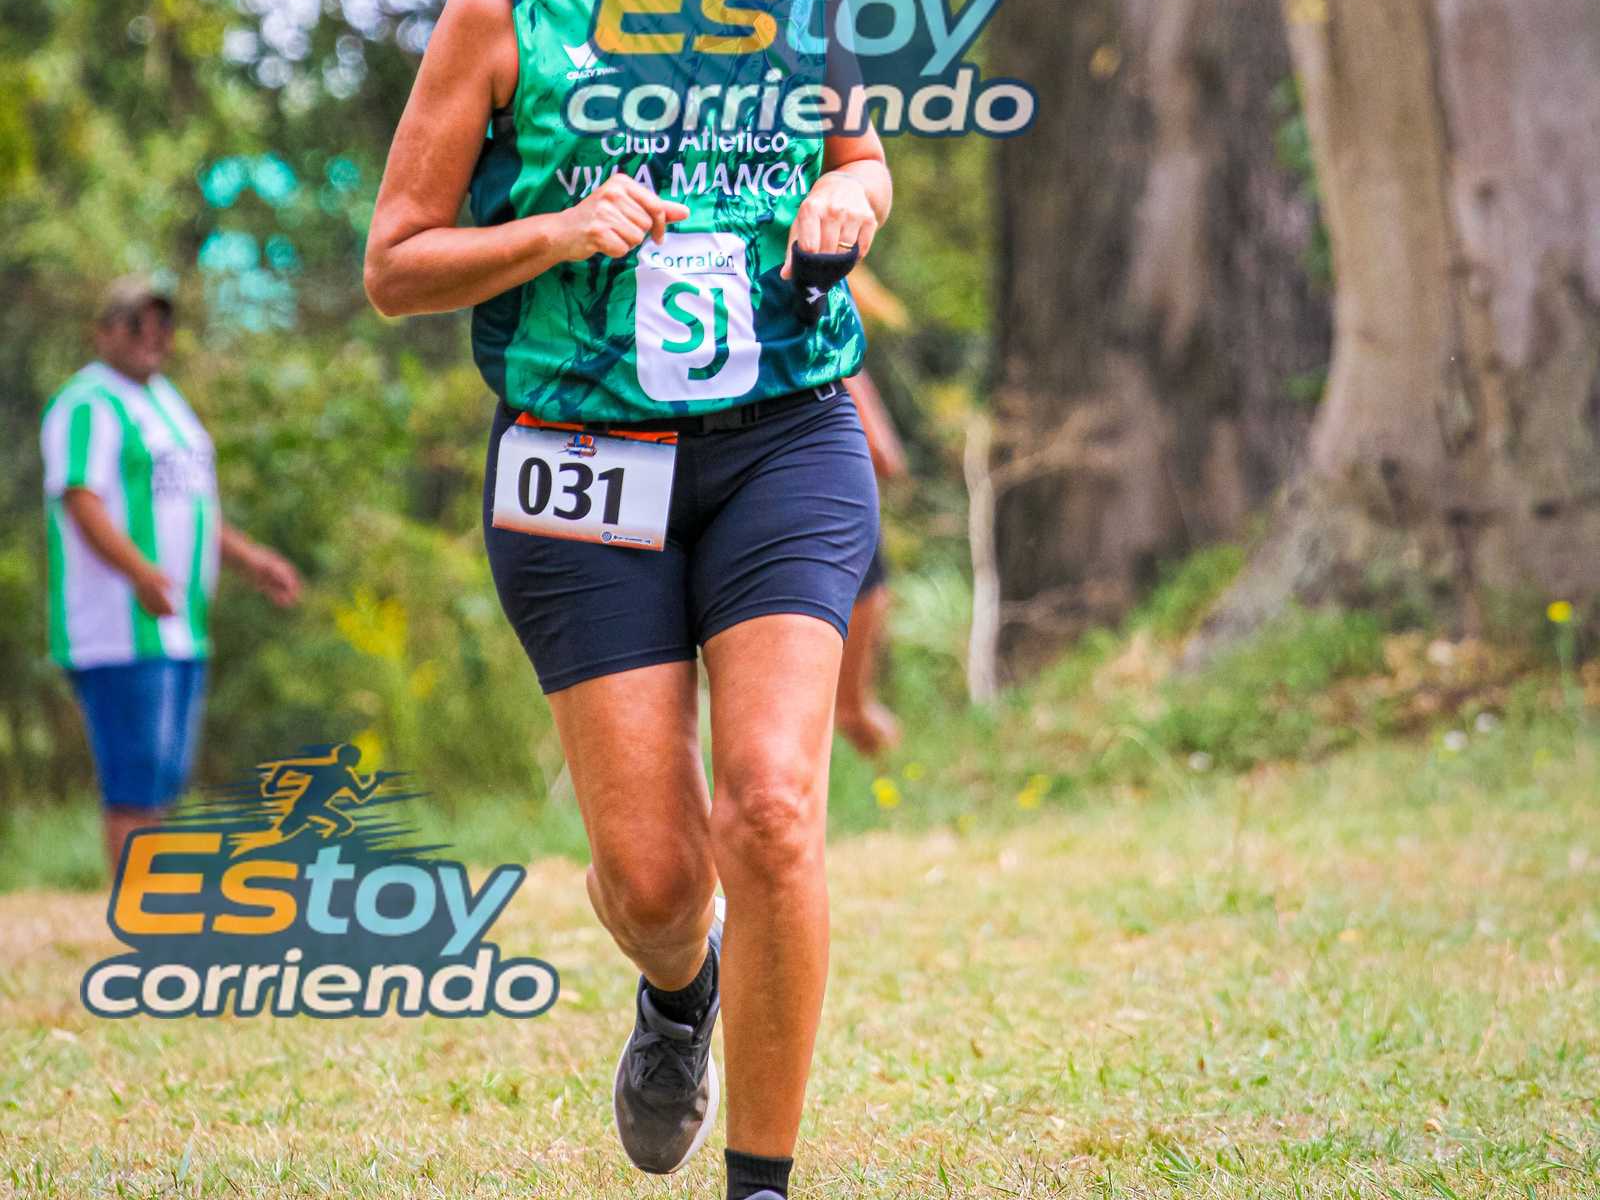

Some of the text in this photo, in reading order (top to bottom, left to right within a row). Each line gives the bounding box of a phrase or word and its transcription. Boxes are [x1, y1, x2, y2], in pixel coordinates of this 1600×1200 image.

[601, 127, 670, 156] Club
[651, 250, 735, 268] Corralón
[662, 281, 730, 380] SJ
[518, 456, 625, 526] 031
